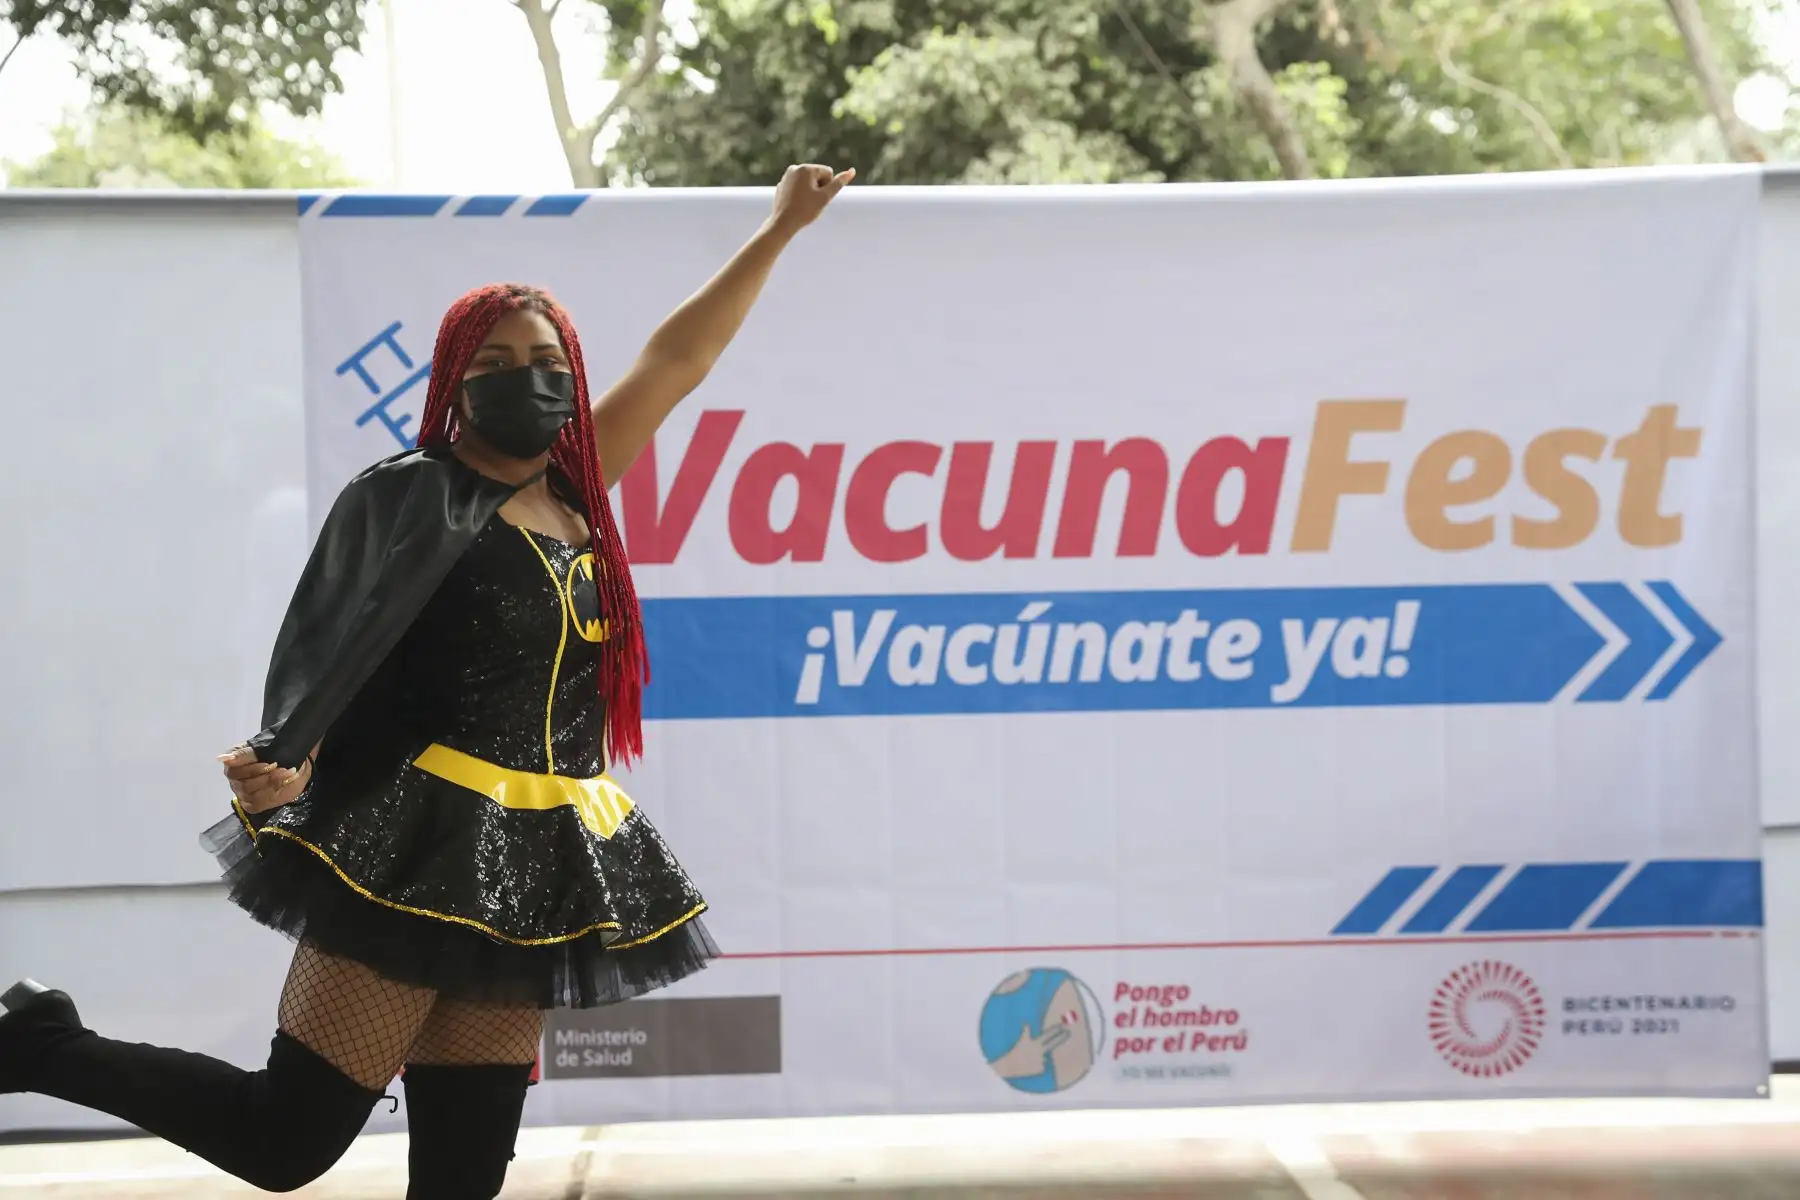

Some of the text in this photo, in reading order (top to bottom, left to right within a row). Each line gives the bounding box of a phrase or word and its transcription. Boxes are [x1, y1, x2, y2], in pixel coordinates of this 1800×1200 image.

[795, 600, 1421, 705] ¡Vacúnate ya!
[1114, 982, 1190, 1006] Pongo
[1562, 995, 1736, 1012] BICENTENARIO
[1113, 1005, 1239, 1027] el hombro
[1563, 1017, 1681, 1035] PERÚ 2021
[556, 1029, 647, 1046] Ministerio
[1113, 1029, 1247, 1060] por el Perú
[556, 1048, 632, 1067] de Salud
